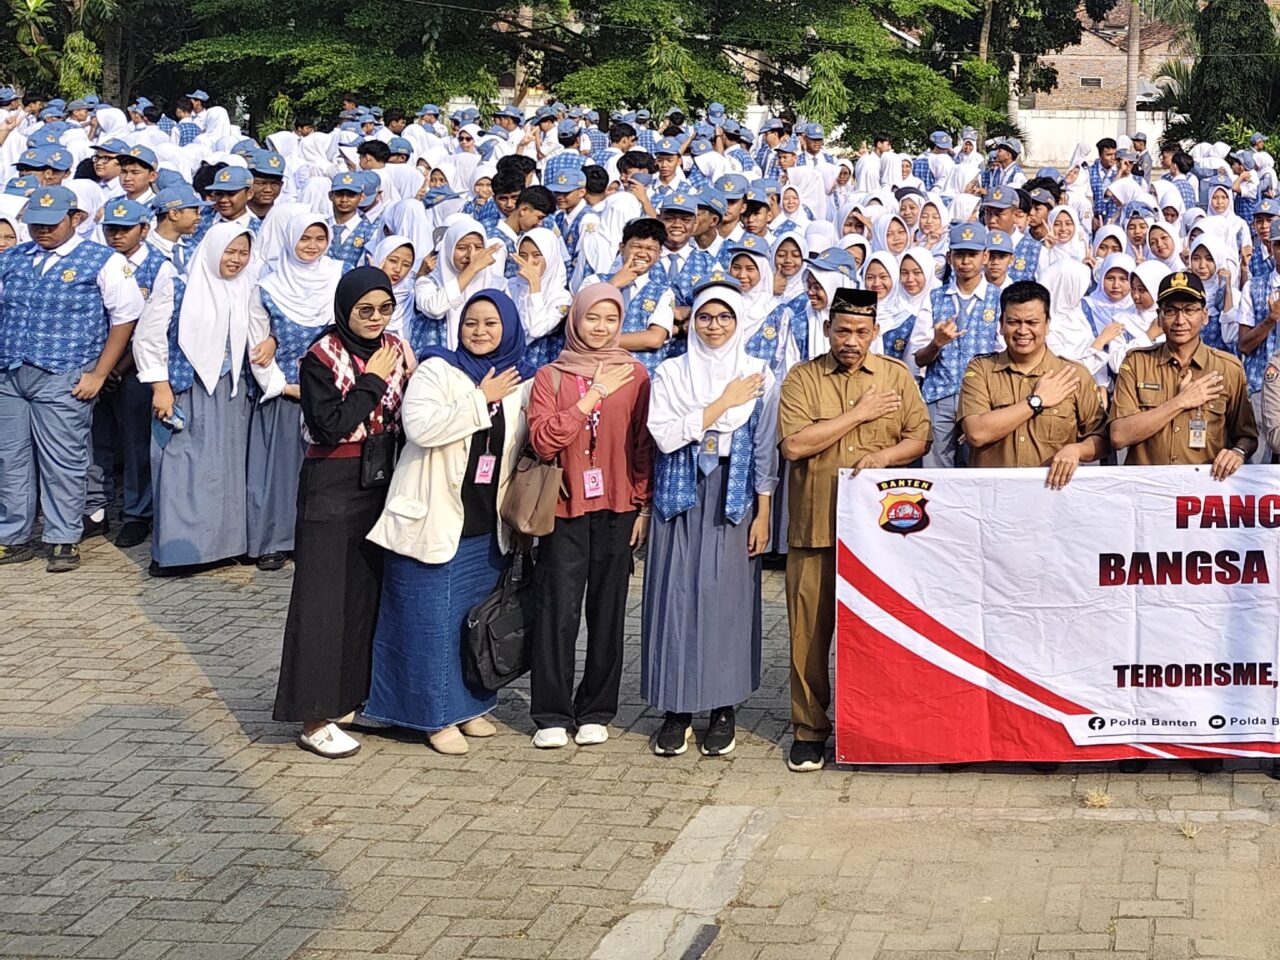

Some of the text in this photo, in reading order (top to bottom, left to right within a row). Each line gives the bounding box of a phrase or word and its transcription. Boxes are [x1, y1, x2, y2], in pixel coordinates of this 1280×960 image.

[880, 479, 929, 490] BANTEN
[1098, 549, 1271, 587] BANGSA
[1112, 662, 1279, 689] TERORISME,
[1110, 717, 1198, 728] Polda Banten
[1230, 716, 1267, 727] Polda
